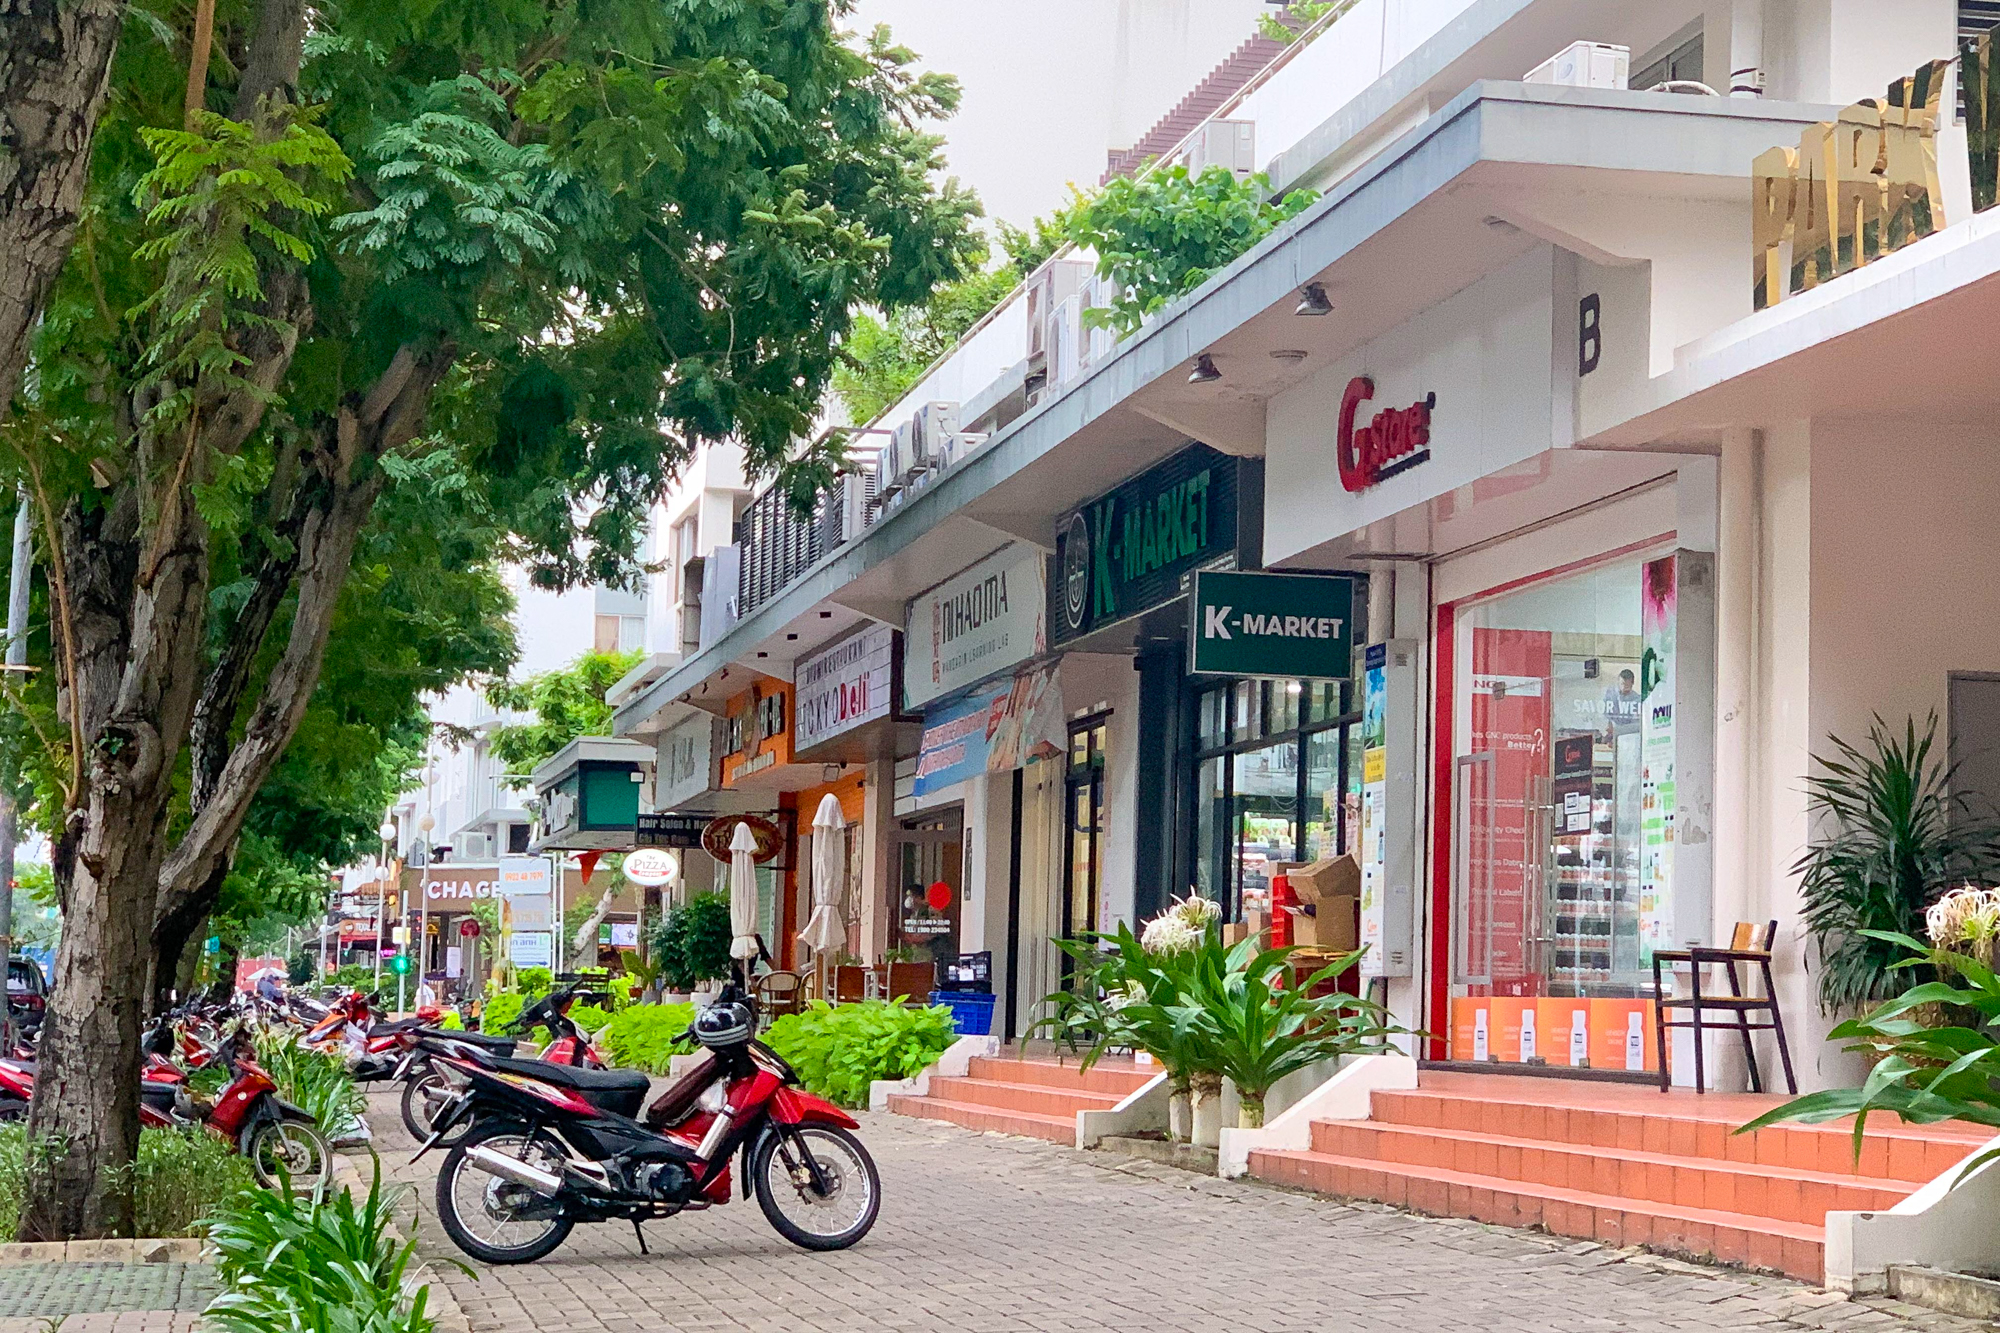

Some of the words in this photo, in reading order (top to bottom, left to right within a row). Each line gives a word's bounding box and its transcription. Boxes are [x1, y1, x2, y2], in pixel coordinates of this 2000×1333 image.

[1580, 293, 1601, 377] B
[1093, 469, 1210, 619] K-MARKET
[1204, 604, 1344, 641] K-MARKET
[639, 818, 658, 829] Hair
[634, 858, 667, 870] PIZZA
[427, 880, 501, 899] CHAGE
